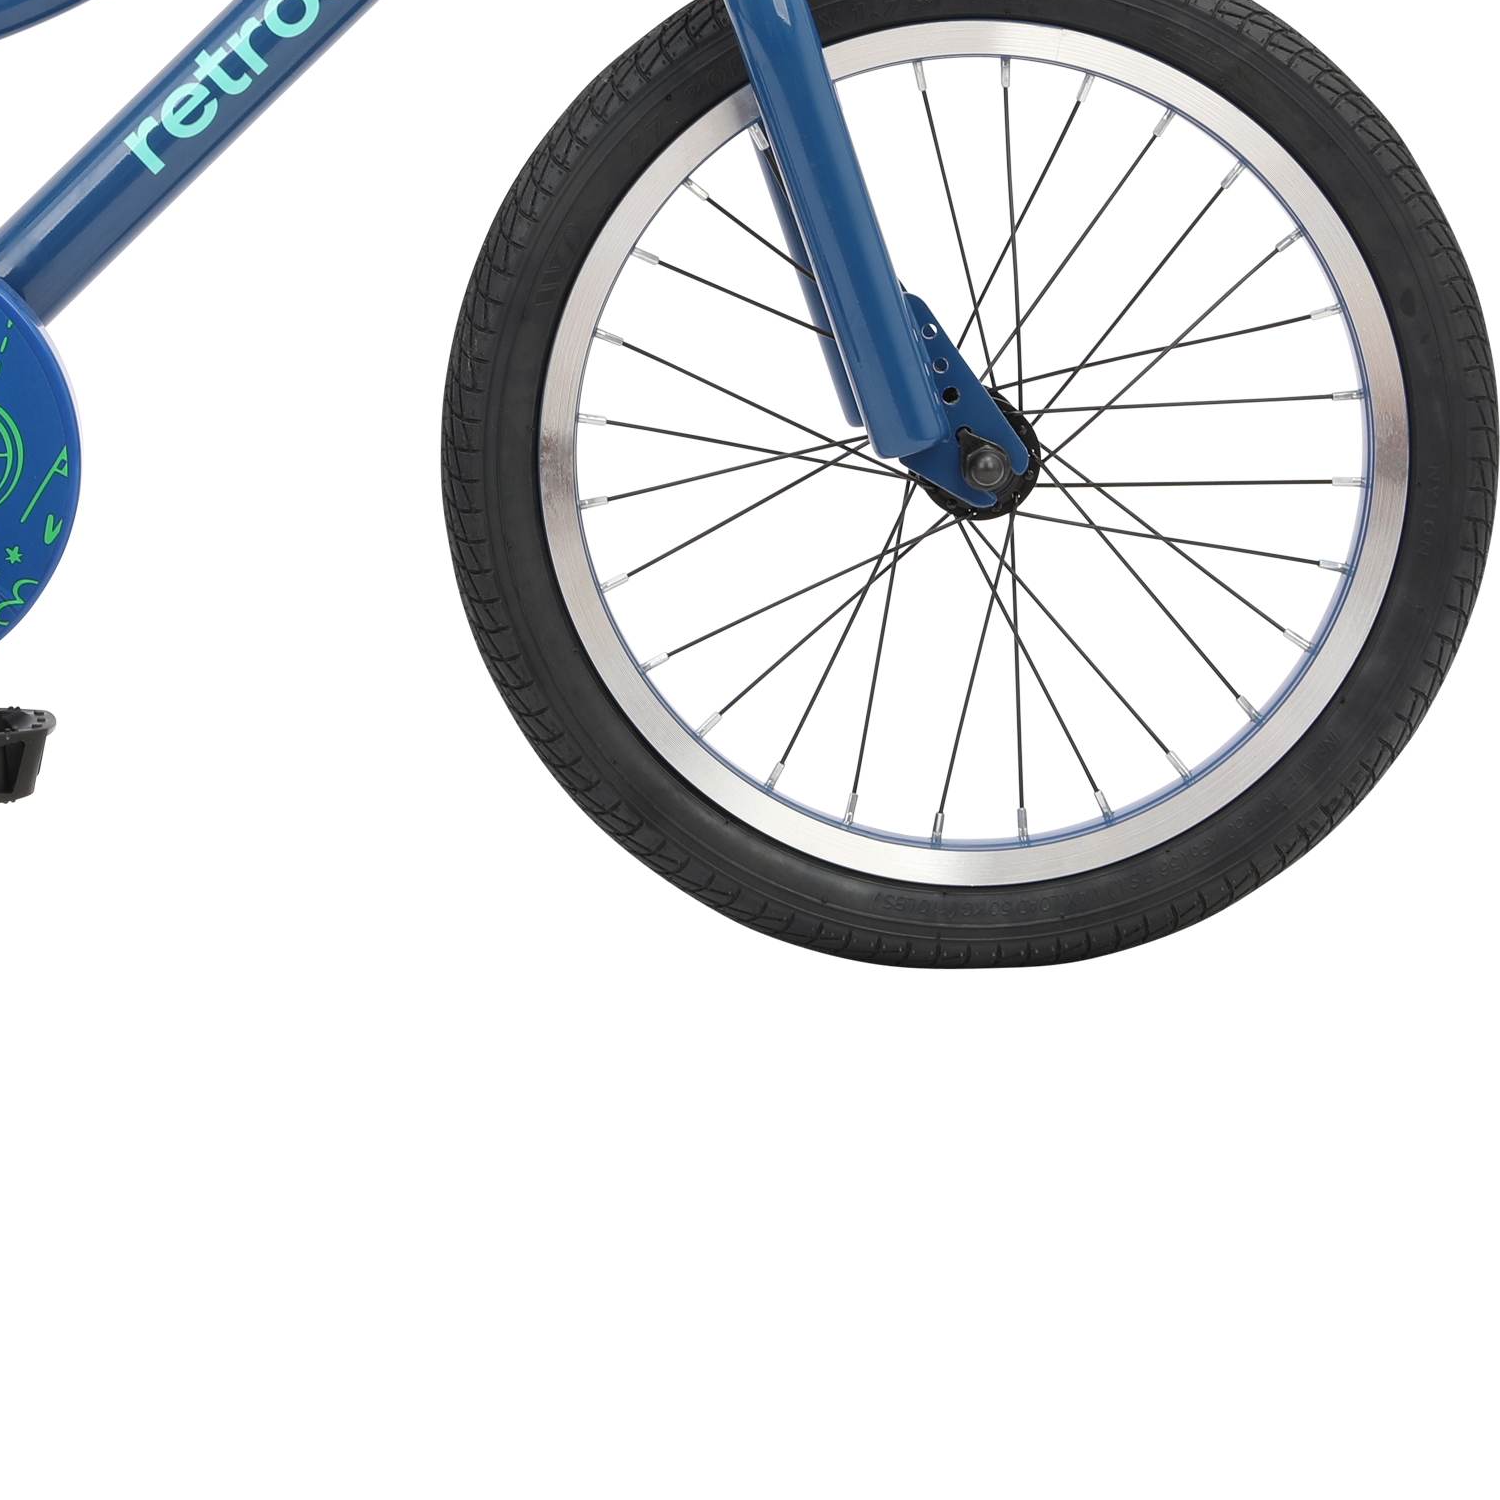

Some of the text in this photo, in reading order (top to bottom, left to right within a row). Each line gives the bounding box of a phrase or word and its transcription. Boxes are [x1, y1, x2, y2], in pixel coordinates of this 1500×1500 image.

[1415, 464, 1440, 557] NYLON
[1280, 727, 1342, 793] INFLATE
[1256, 787, 1285, 815] TO
